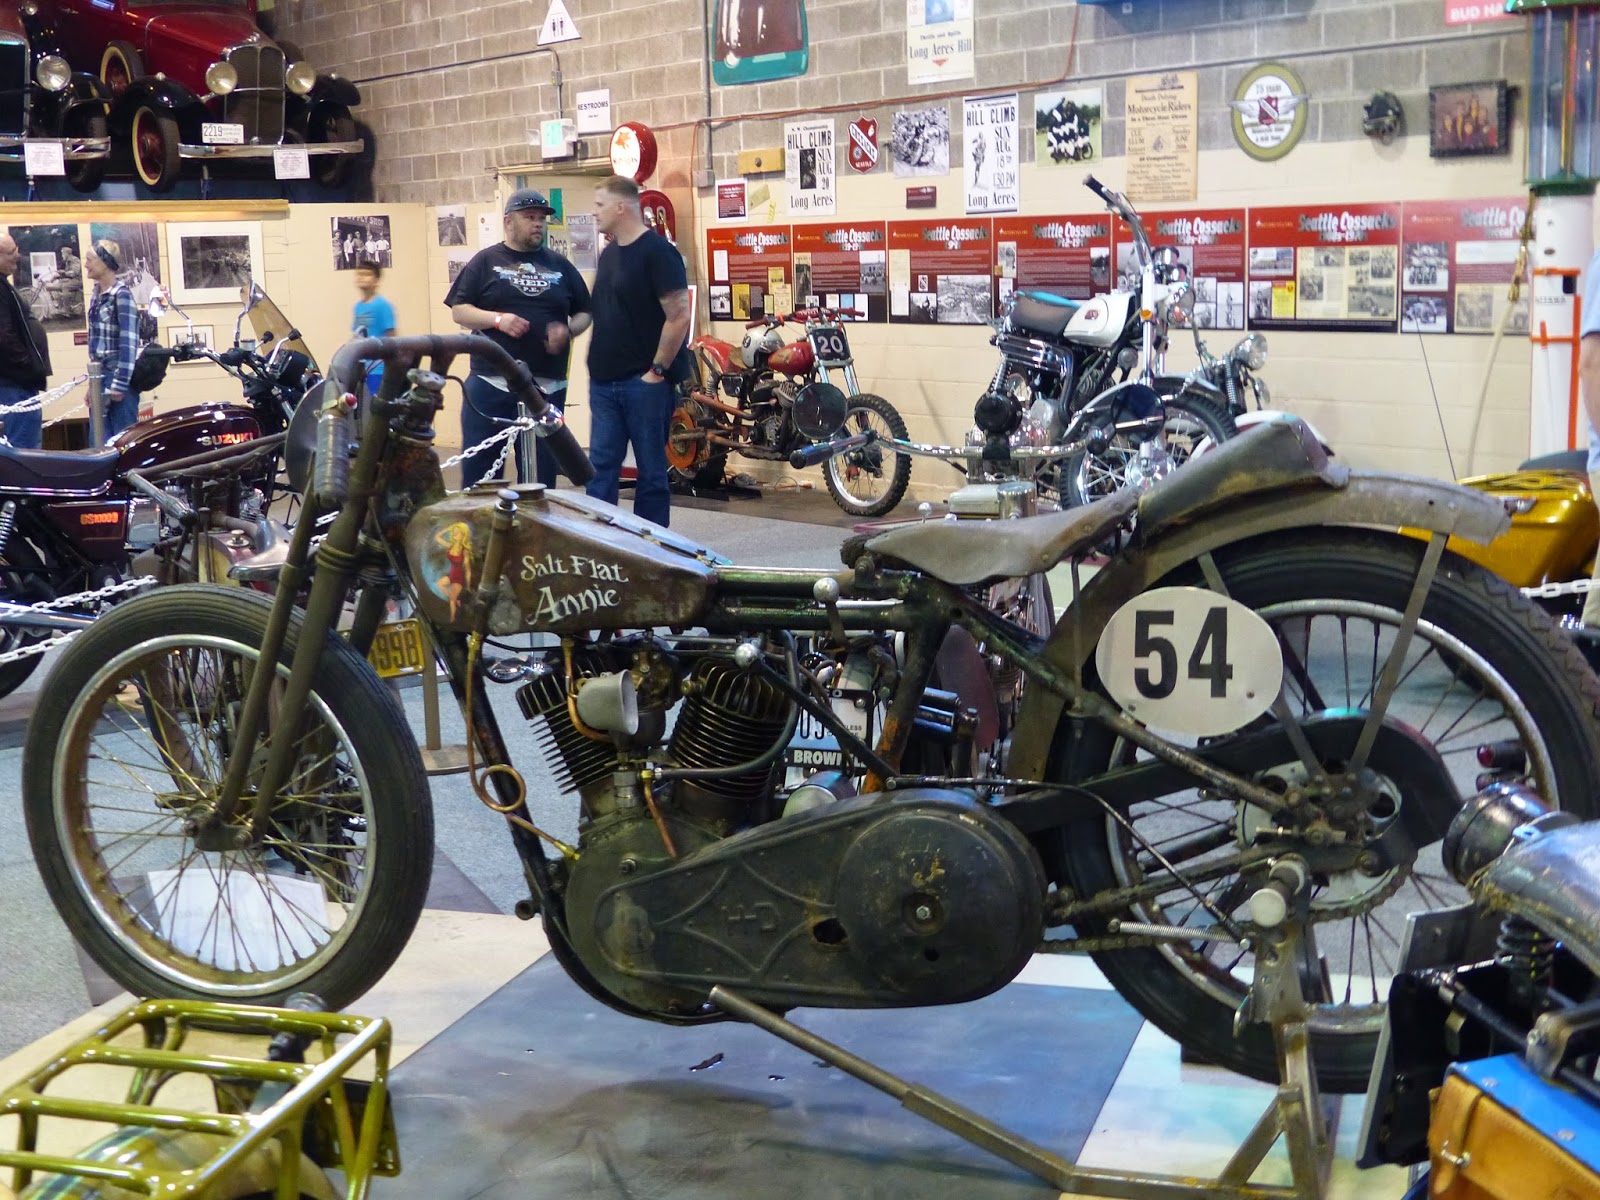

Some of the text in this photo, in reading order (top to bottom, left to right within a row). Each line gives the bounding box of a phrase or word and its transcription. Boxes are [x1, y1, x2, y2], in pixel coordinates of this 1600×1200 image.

[1450, 6, 1480, 20] BUD
[909, 38, 972, 59] Long Acres Hill
[577, 101, 609, 110] RESTROOMS
[1128, 100, 1191, 114] Motorcycle Riders
[966, 106, 1016, 126] HILL CLIMB
[203, 125, 222, 136] 2219
[994, 126, 1011, 139] SUN
[787, 130, 832, 149] HILL CLIMB
[817, 148, 832, 161] SUN
[818, 161, 832, 175] AUG
[821, 177, 830, 190] 20
[790, 193, 833, 210] Long Acres
[968, 191, 1016, 208] Long Acres
[1157, 218, 1192, 234] Seattle
[1193, 217, 1241, 234] Cossacks
[1299, 212, 1338, 231] Seattle
[1340, 211, 1395, 231] Cossacks
[1462, 207, 1507, 227] Seattle
[824, 229, 849, 243] Seattle
[849, 228, 883, 243] Cossacks
[923, 225, 950, 241] Seattle
[950, 224, 988, 241] Cossacks
[1033, 222, 1064, 238] Seattle
[1064, 221, 1107, 238] Cossacks
[735, 231, 788, 247] Seattle Cossacks
[512, 277, 548, 287] HED
[817, 333, 844, 354] 20
[201, 431, 255, 447] SUZUKI
[520, 553, 630, 583] Salt Flat
[525, 584, 622, 626] Annie
[1134, 606, 1234, 699] 54
